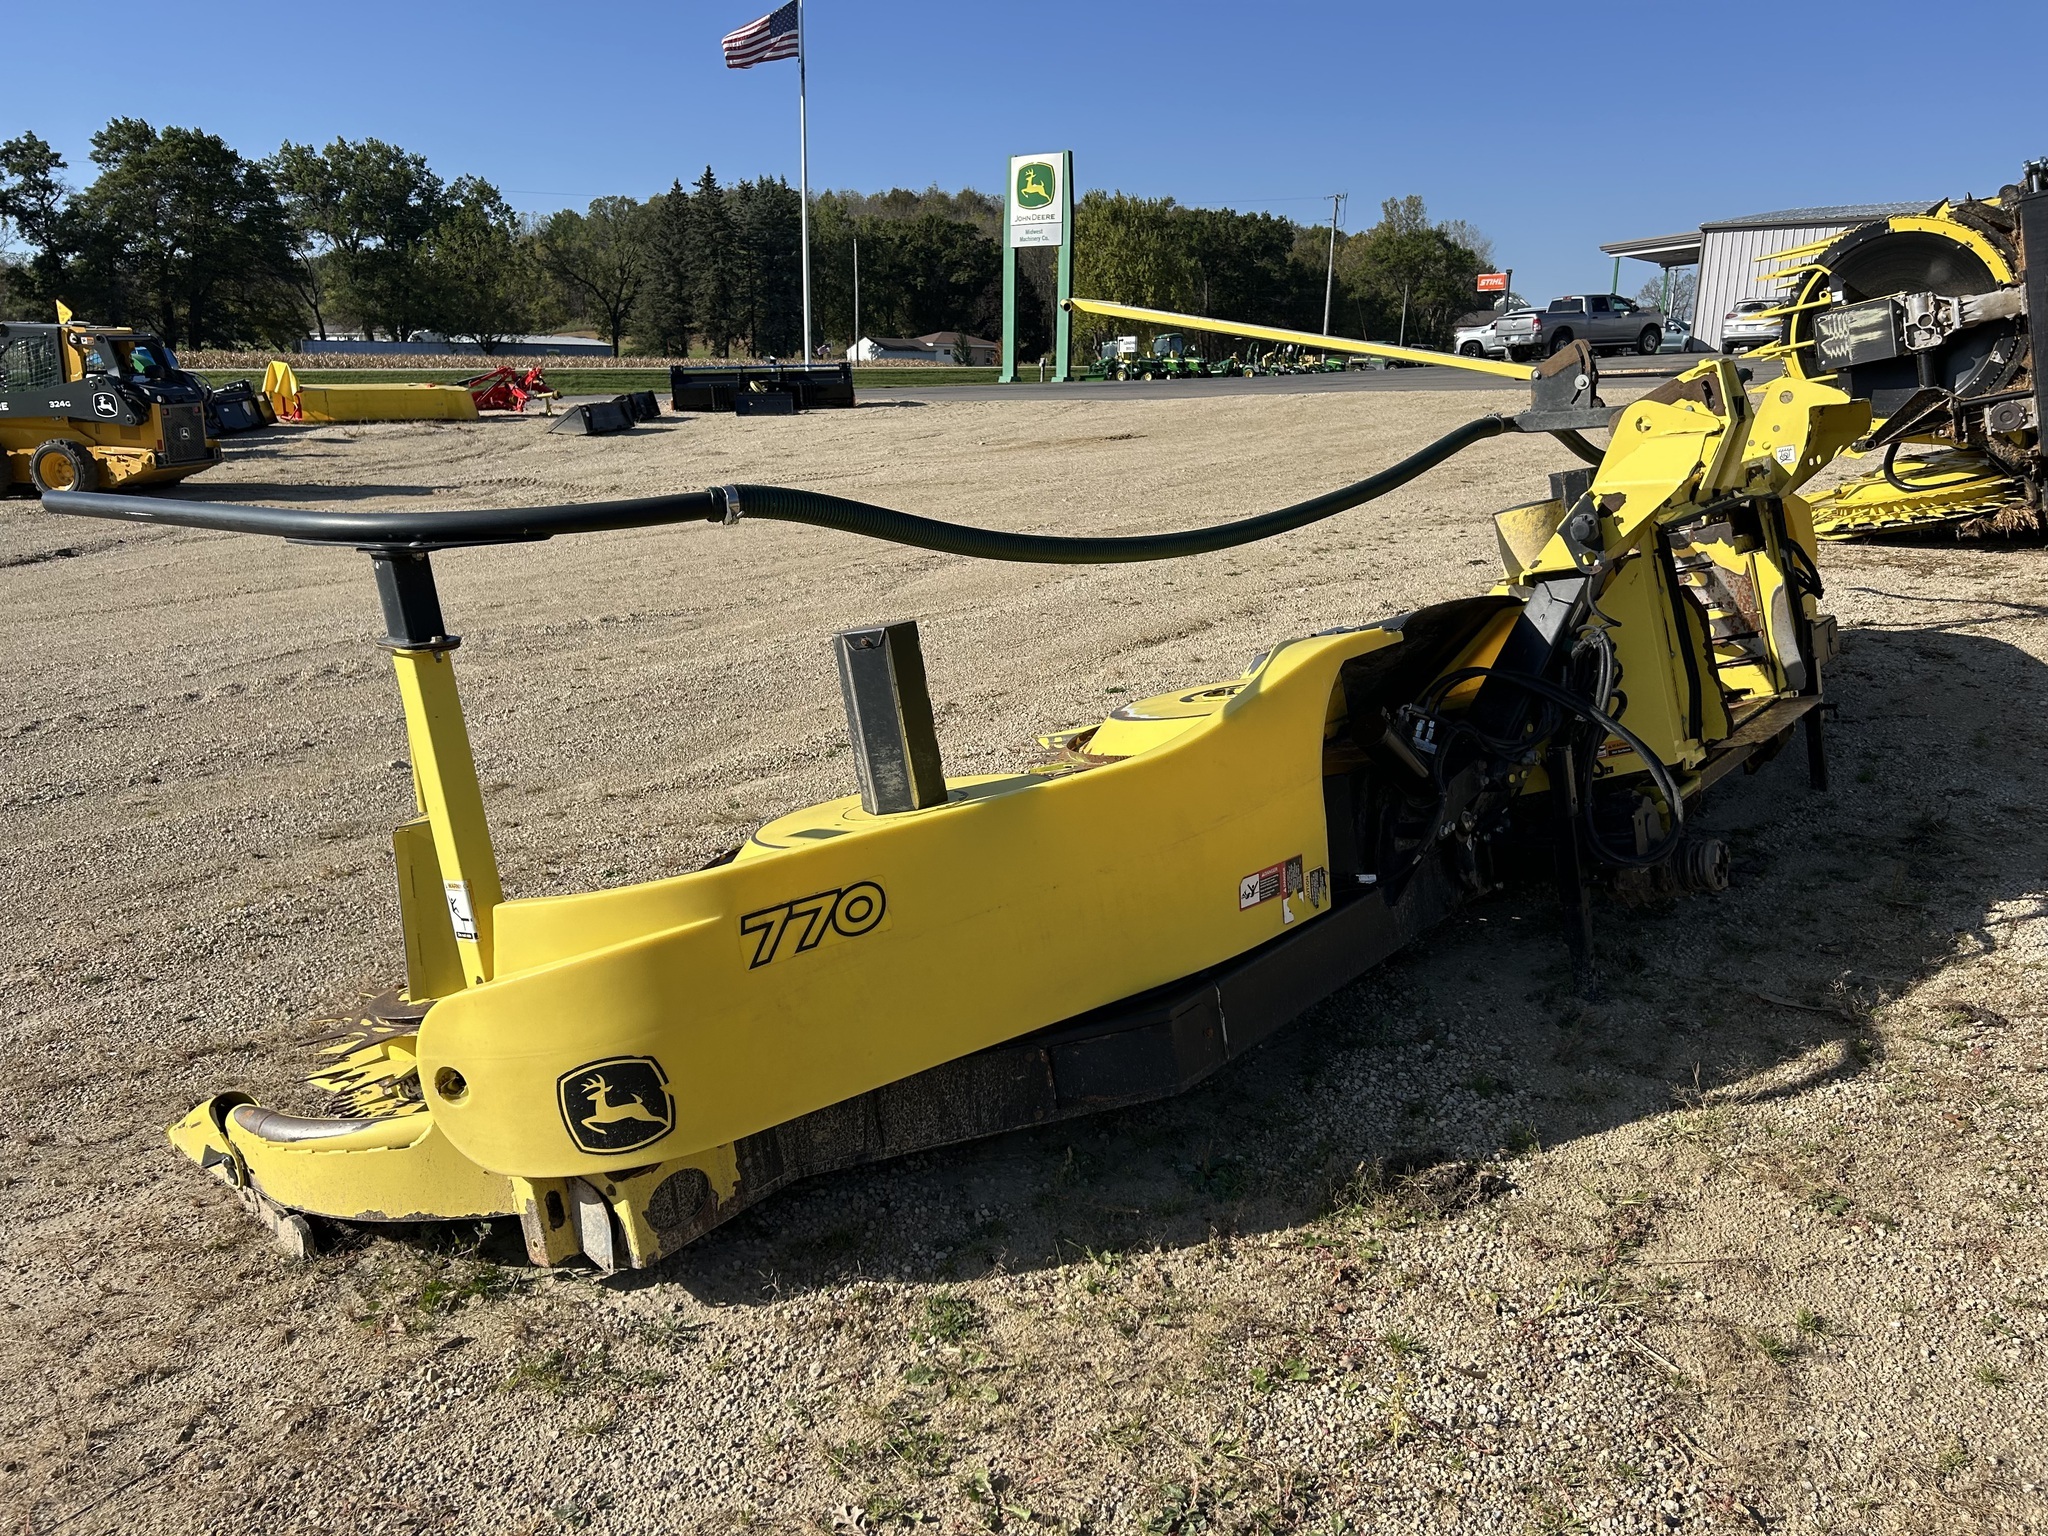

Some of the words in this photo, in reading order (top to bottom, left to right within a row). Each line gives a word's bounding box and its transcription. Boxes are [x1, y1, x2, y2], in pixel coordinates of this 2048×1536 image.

[1014, 214, 1032, 222] JOHN
[1032, 213, 1055, 221] DEERE
[1479, 278, 1503, 286] STIHL
[49, 400, 71, 409] 324G
[1264, 866, 1278, 874] DANGER
[740, 880, 887, 970] 770
